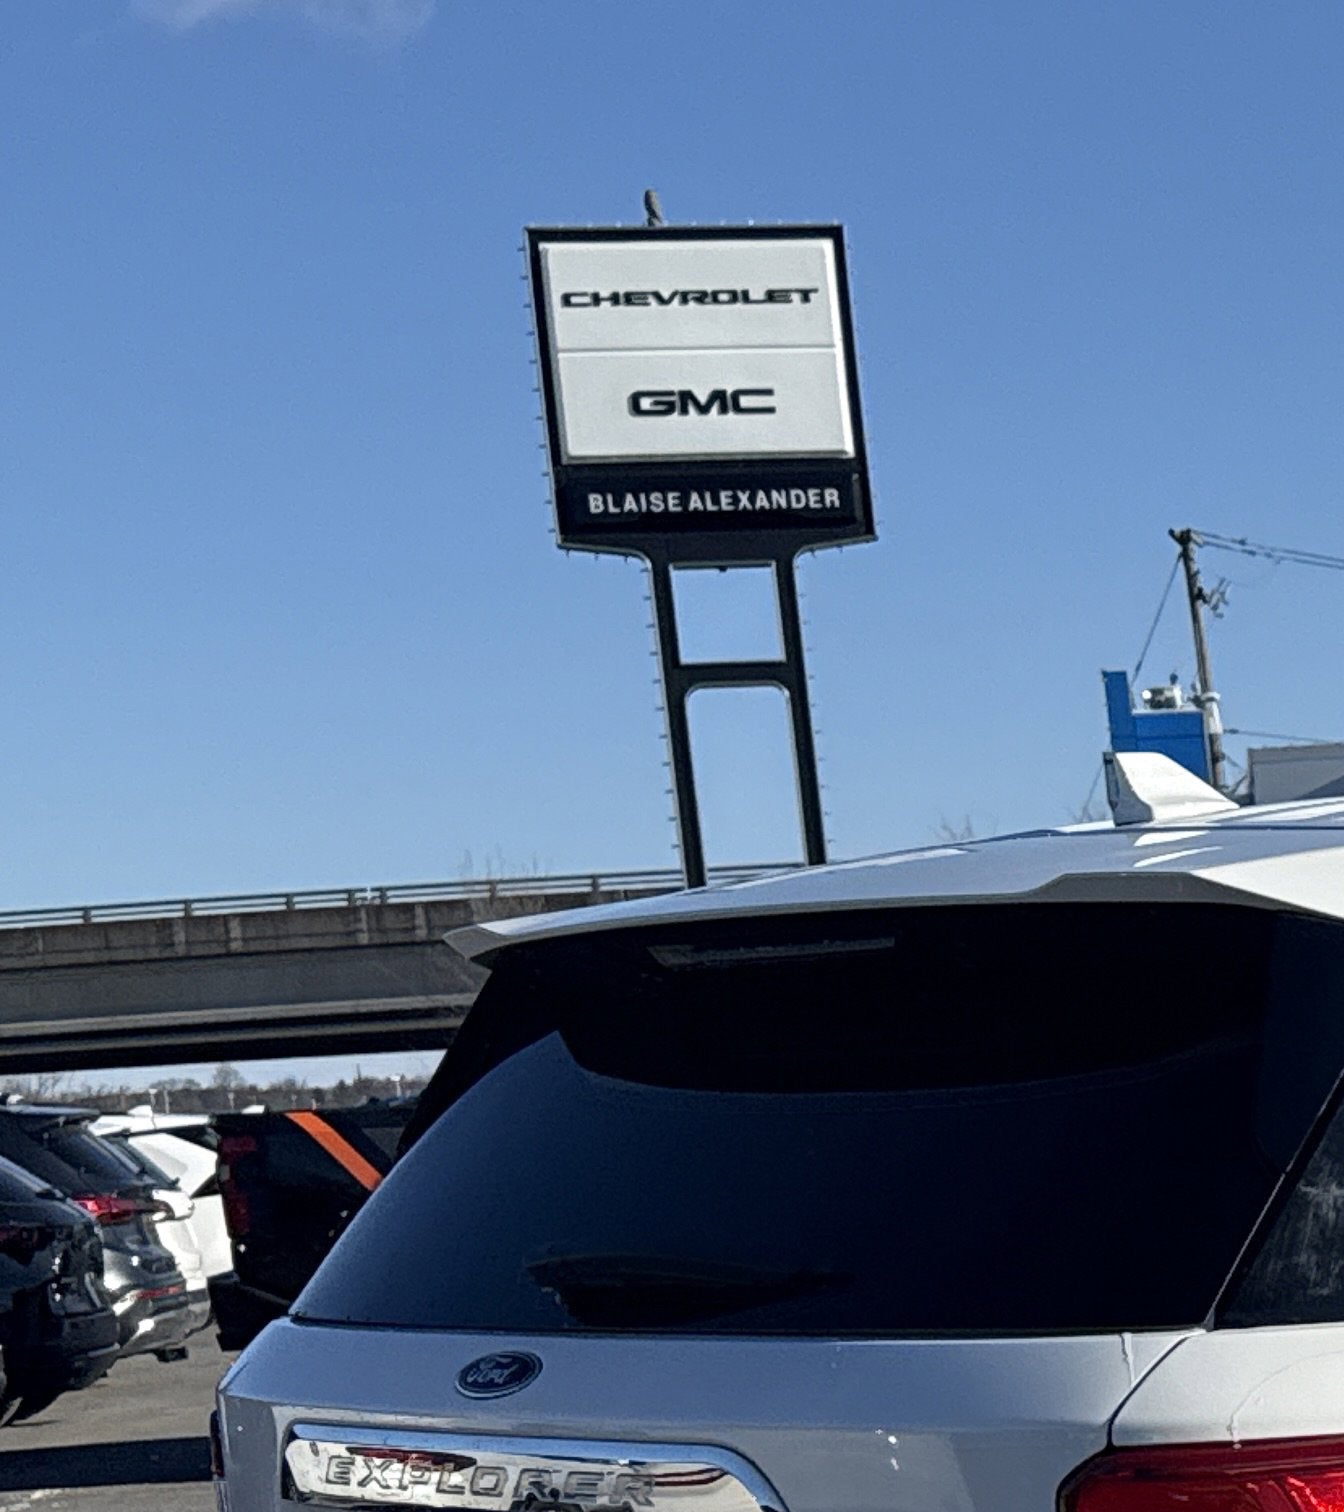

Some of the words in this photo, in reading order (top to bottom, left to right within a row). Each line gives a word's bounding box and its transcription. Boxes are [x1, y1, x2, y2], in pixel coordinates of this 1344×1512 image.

[561, 288, 818, 308] CHEVROLET
[628, 388, 776, 417] GMC
[588, 492, 683, 514] BLAISE
[688, 487, 840, 512] ALEXANDER
[325, 1454, 655, 1508] EXPLORER
